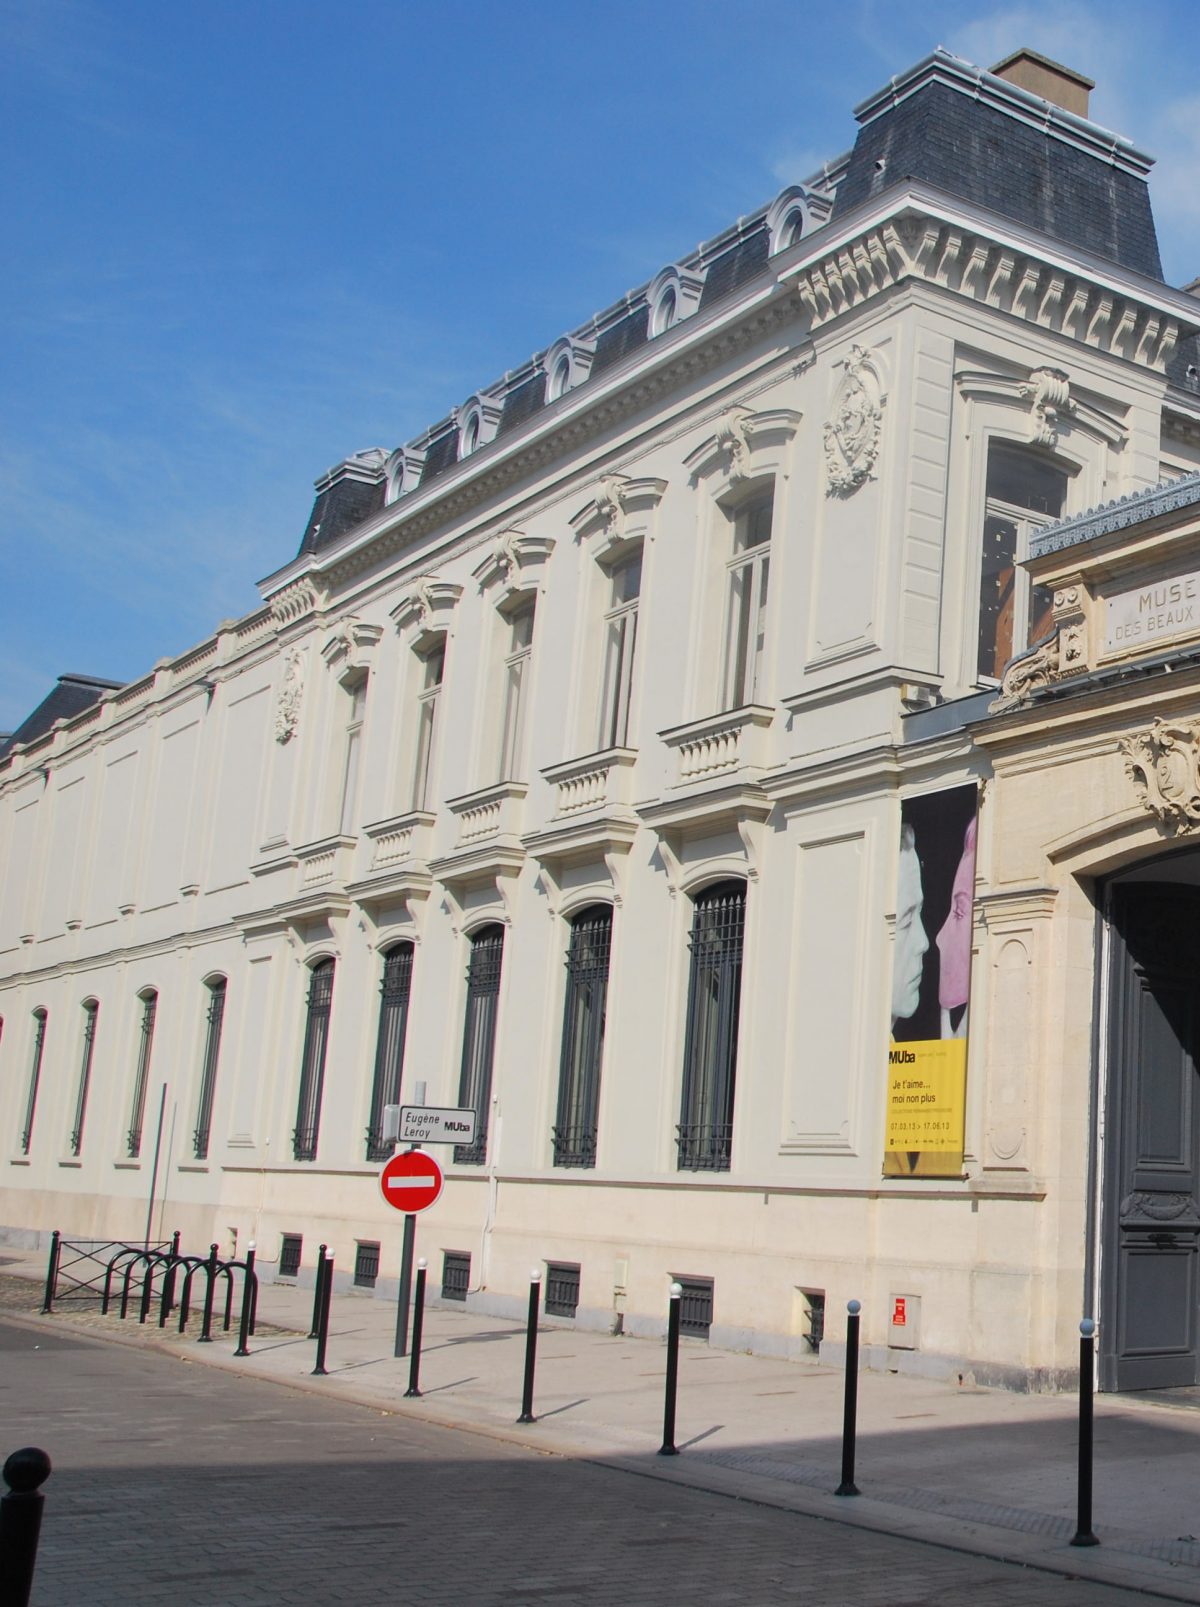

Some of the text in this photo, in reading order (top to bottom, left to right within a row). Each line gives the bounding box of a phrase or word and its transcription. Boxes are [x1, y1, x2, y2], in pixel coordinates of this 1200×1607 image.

[1115, 620, 1142, 640] DES
[1147, 606, 1193, 632] BEAUX
[889, 1051, 916, 1064] MUba
[892, 1080, 902, 1090] Je
[892, 1093, 936, 1104] moi non plus
[405, 1112, 470, 1132] Eugène MUba
[404, 1126, 431, 1140] Leroy
